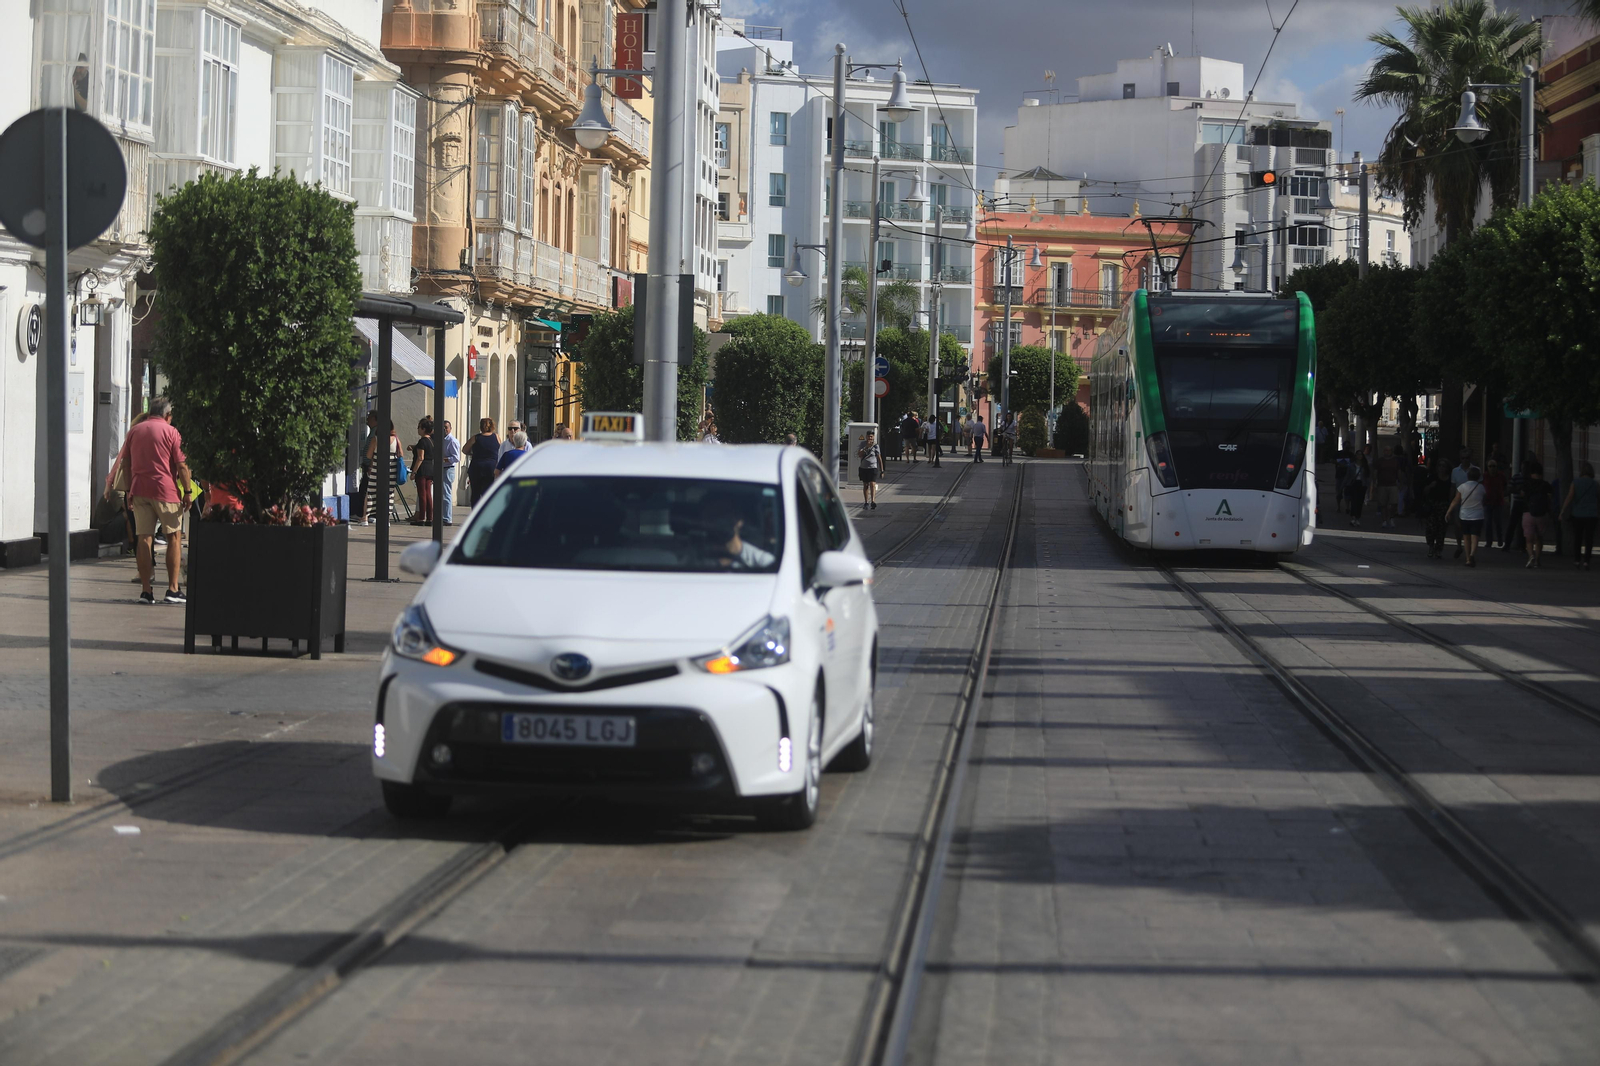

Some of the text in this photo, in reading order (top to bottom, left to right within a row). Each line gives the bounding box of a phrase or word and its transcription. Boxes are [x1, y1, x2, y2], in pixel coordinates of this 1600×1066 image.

[623, 19, 638, 92] HOTEL
[593, 415, 625, 432] TAXI
[1217, 443, 1238, 452] CAF
[519, 716, 631, 743] 8045 LGJ
